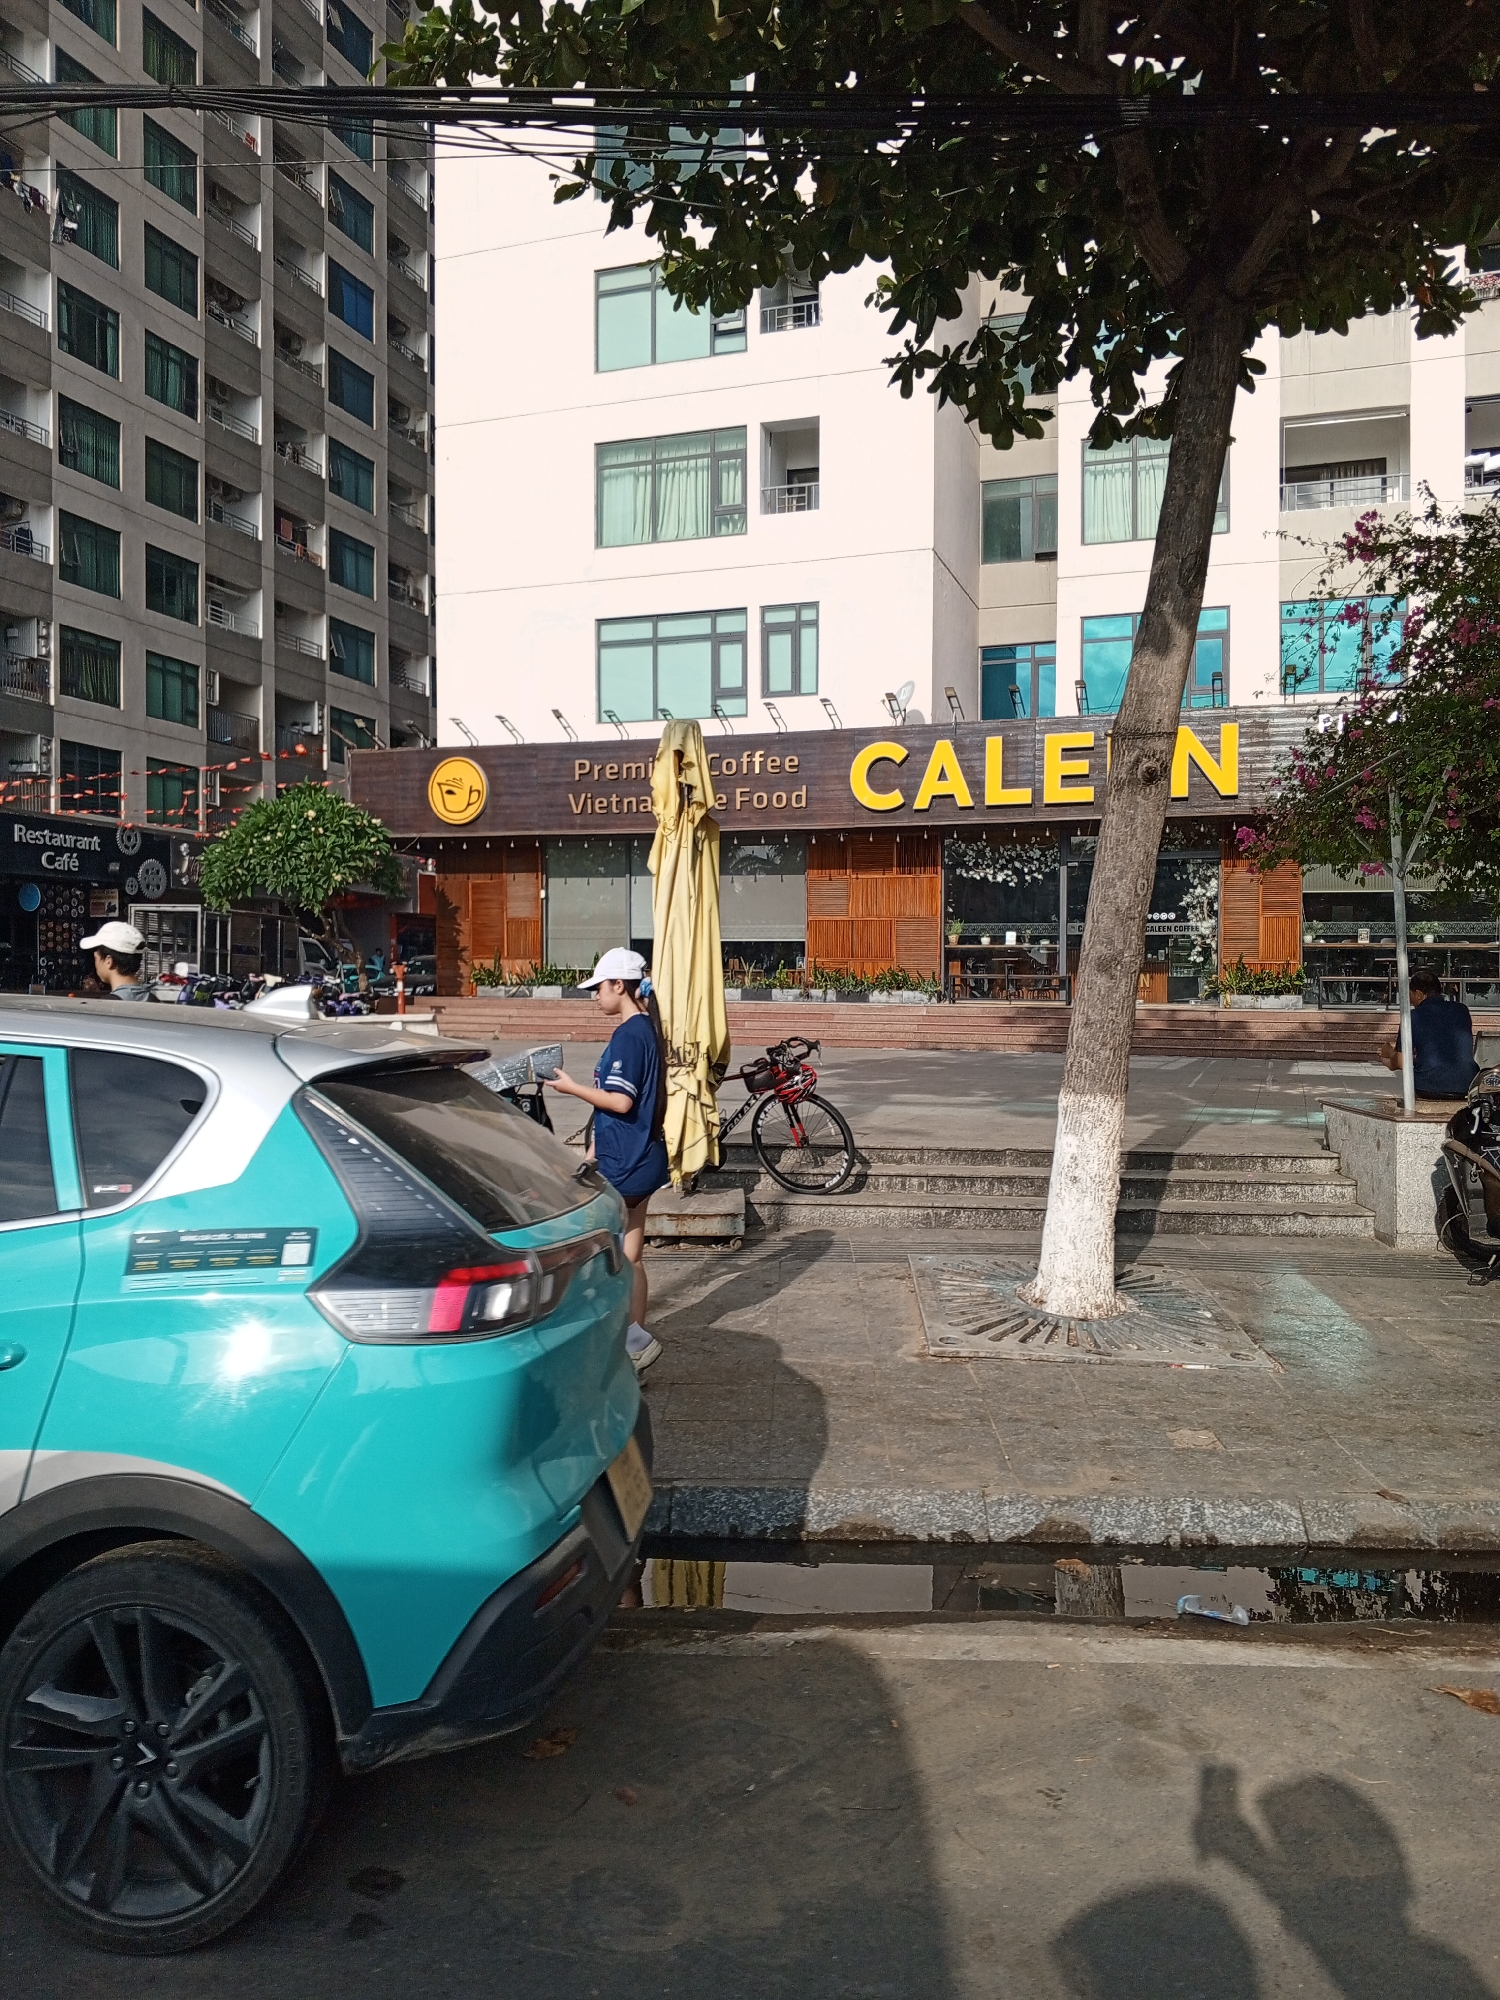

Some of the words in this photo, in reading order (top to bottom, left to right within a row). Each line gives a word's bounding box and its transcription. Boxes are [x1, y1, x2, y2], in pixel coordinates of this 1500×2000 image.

[574, 756, 654, 781] Premi
[707, 750, 800, 776] Coffee
[849, 722, 1239, 812] CALEN
[568, 792, 728, 815] Vietnae
[735, 784, 808, 811] Food
[13, 823, 101, 852] Restaurant
[41, 851, 80, 871] Café
[1145, 925, 1172, 933] CALEEN
